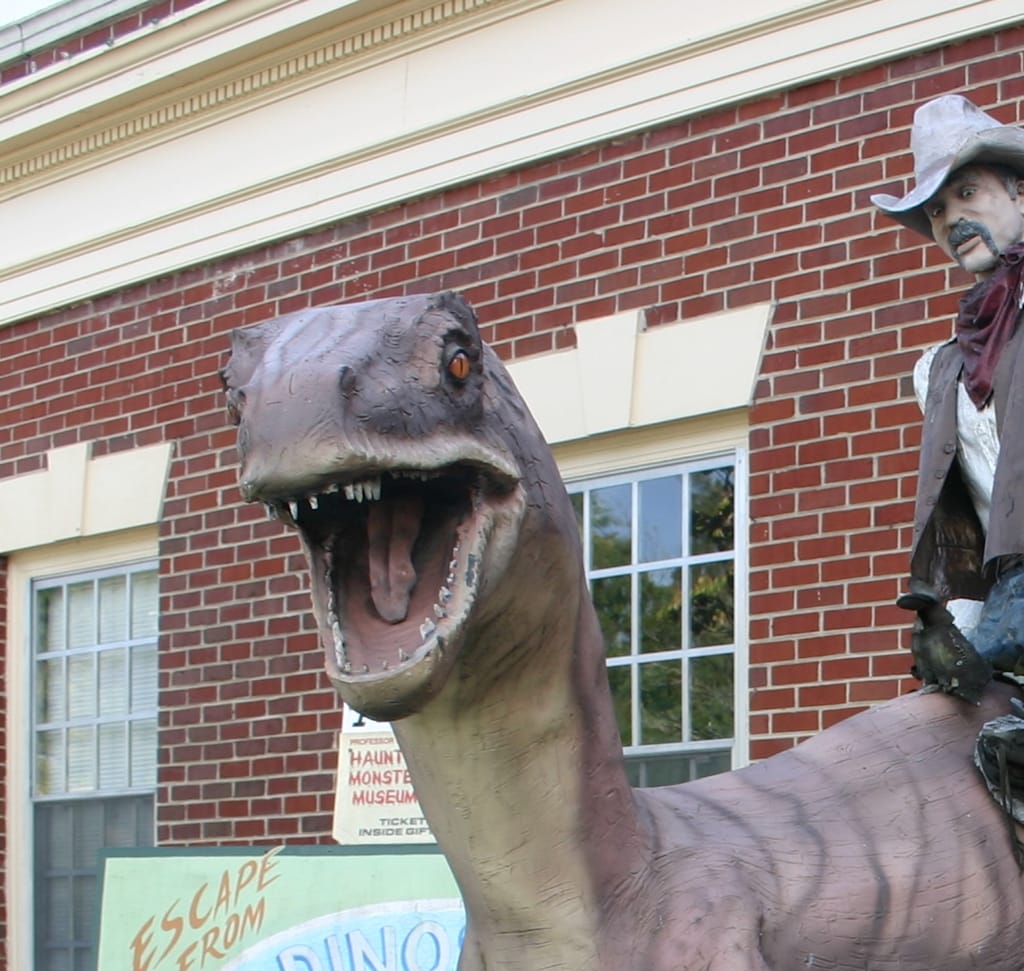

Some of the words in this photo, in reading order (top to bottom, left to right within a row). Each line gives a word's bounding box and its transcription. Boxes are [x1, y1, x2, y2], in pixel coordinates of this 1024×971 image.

[352, 789, 418, 805] MUSEUM
[358, 828, 403, 836] INSIDE
[406, 827, 433, 836] GIF
